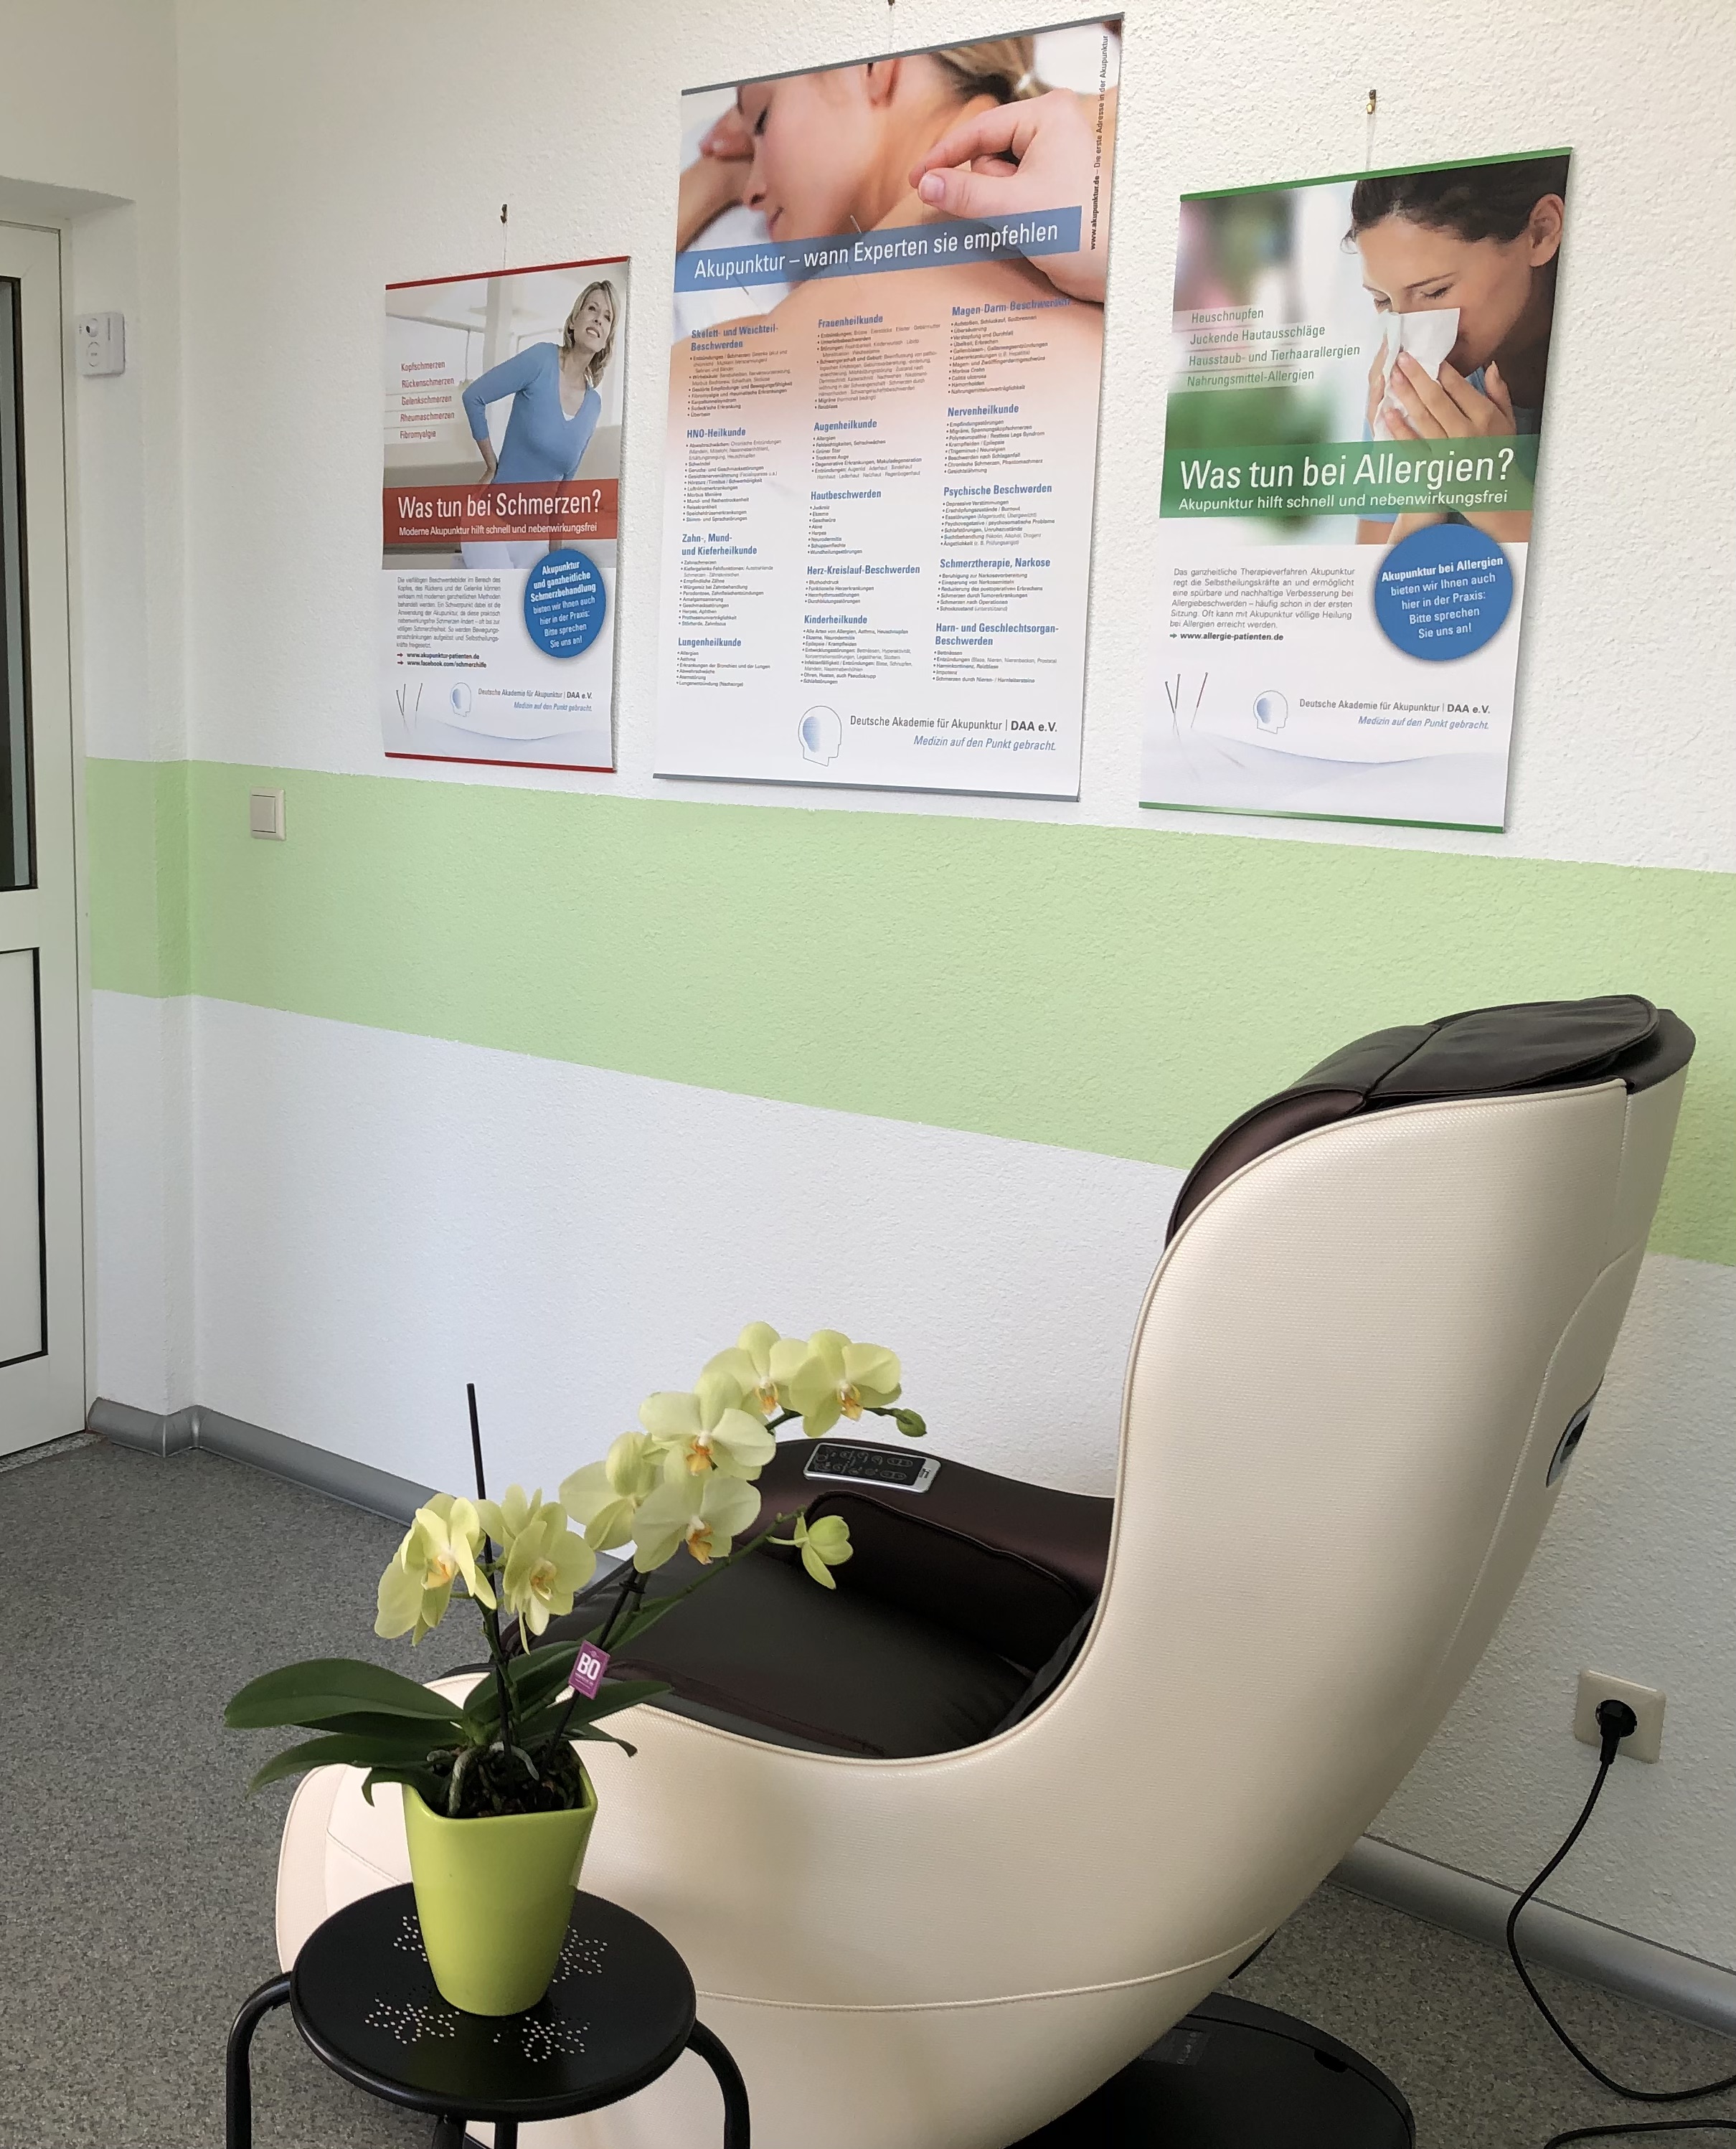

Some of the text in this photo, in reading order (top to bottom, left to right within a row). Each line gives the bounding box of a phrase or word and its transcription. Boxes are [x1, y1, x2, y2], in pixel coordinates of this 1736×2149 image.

[1100, 36, 1108, 77] Akupunktur
[694, 224, 1058, 279] Akupunktur wann Experten sie empfehlen
[819, 314, 883, 328] Frauenheilkunde
[1192, 308, 1263, 323] Heuschnupfen
[692, 323, 778, 339] Skelett- und Weichteil-
[1190, 325, 1325, 345] Juckende Hautausschläge
[692, 340, 742, 351] Beschwerden
[1189, 344, 1360, 366] Hausstaub- und Tierhaarallergien
[401, 362, 445, 372] Kopfschmerzen
[402, 378, 454, 387] Rückenschmerzen
[1187, 370, 1314, 387] Nahrungsmittel-Allergien
[402, 395, 452, 405] Gelenkschmerzen
[400, 412, 454, 422] Rheumaschmerzen
[948, 404, 1019, 417] Nervenheilkunde
[813, 419, 877, 433] Augenheilkunde
[400, 430, 435, 439] Fibromyalgie
[687, 428, 746, 438] HNO-Heilkunde
[1180, 448, 1514, 489] Was tun bei Allergien?
[811, 489, 882, 500] Hautbeschwerden
[944, 483, 1052, 498] Psychische Beschwerden
[398, 489, 601, 518] Was tun bei Schmerzen?
[1179, 490, 1508, 512] Akupunktur hilft schnell und nebenwirkungsfrei
[399, 522, 597, 537] Moderne Akupunktur hilft schnell und nebenwirkungsfrei
[682, 533, 732, 543] Zahn-, Mund-
[681, 546, 757, 555] und Kieferheilkunde
[542, 562, 580, 575] Akupunktur
[940, 557, 1050, 569] Schmerztherapie, Narkose
[1382, 557, 1503, 582] Akupunktur bei Allergien
[807, 565, 920, 575] Herz-Kreislauf-Beschwerden
[1191, 568, 1237, 577] ganzheitliche
[534, 571, 590, 589] und ganzheitliche
[1391, 573, 1496, 596] bieten wir Ihnen auch
[531, 584, 595, 603] Schmerzbehandlung
[1402, 590, 1486, 610] hier in der Praxis:
[533, 605, 551, 614] bieten
[562, 600, 579, 608] Ihnen
[580, 596, 595, 605] auch
[1255, 600, 1278, 609] häufig
[570, 609, 590, 620] Praxis:
[804, 615, 867, 624] Kinderheilkunde
[1295, 610, 1319, 620] völlige
[1322, 610, 1351, 620] Heilung
[1410, 608, 1480, 624] Bitte sprechen
[560, 624, 587, 635] sprechen
[936, 623, 1059, 635] Harn- und Geschlechtsorgan-
[1183, 620, 1214, 629] Allergien
[1418, 623, 1471, 638] Sie uns an!
[572, 636, 582, 644] an!
[679, 638, 741, 648] Lungenheilkunde
[935, 636, 993, 645] Beschwerden
[1180, 633, 1283, 641] www.allergie-patienten.de
[1300, 699, 1491, 714] Deutsche Akademie für Akupunktur DAA e.V.
[851, 716, 1057, 732] Deutsche Akademie für Akupunktur DAA e.V.
[1358, 716, 1390, 725] Medizin
[1392, 717, 1405, 727] auf
[1424, 719, 1448, 728] Punkt
[914, 735, 1056, 751] Medizin auf den Punkt gebracht.
[577, 1653, 600, 1681] BO
